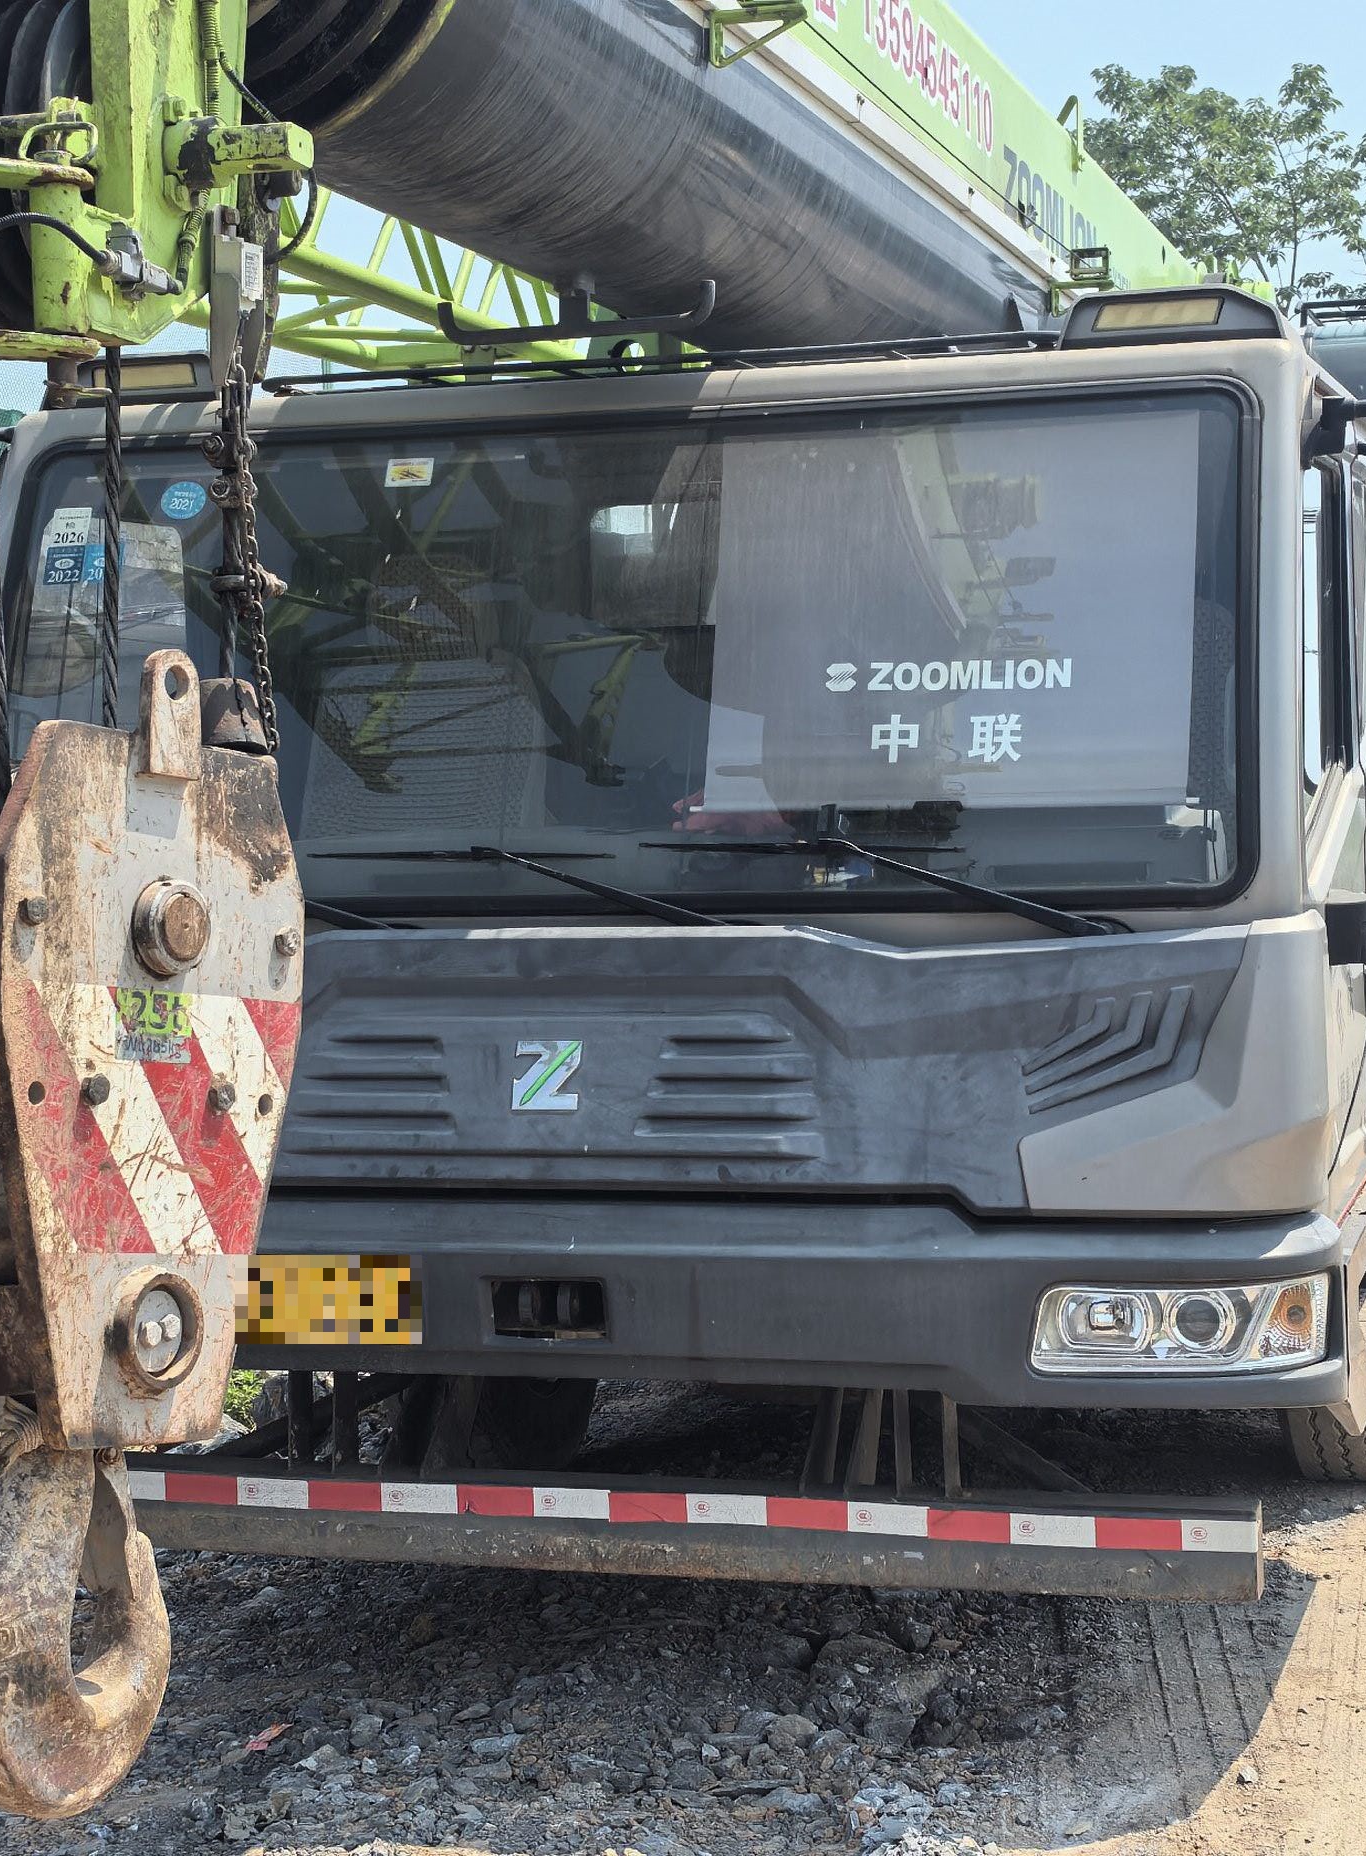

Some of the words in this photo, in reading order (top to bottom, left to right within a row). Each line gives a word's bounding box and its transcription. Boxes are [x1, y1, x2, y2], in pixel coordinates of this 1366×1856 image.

[1003, 143, 1097, 268] ZOOMLION
[53, 532, 85, 544] 2026
[47, 569, 80, 583] 2022
[87, 568, 104, 581] 20
[867, 658, 1073, 691] ZOOMLION
